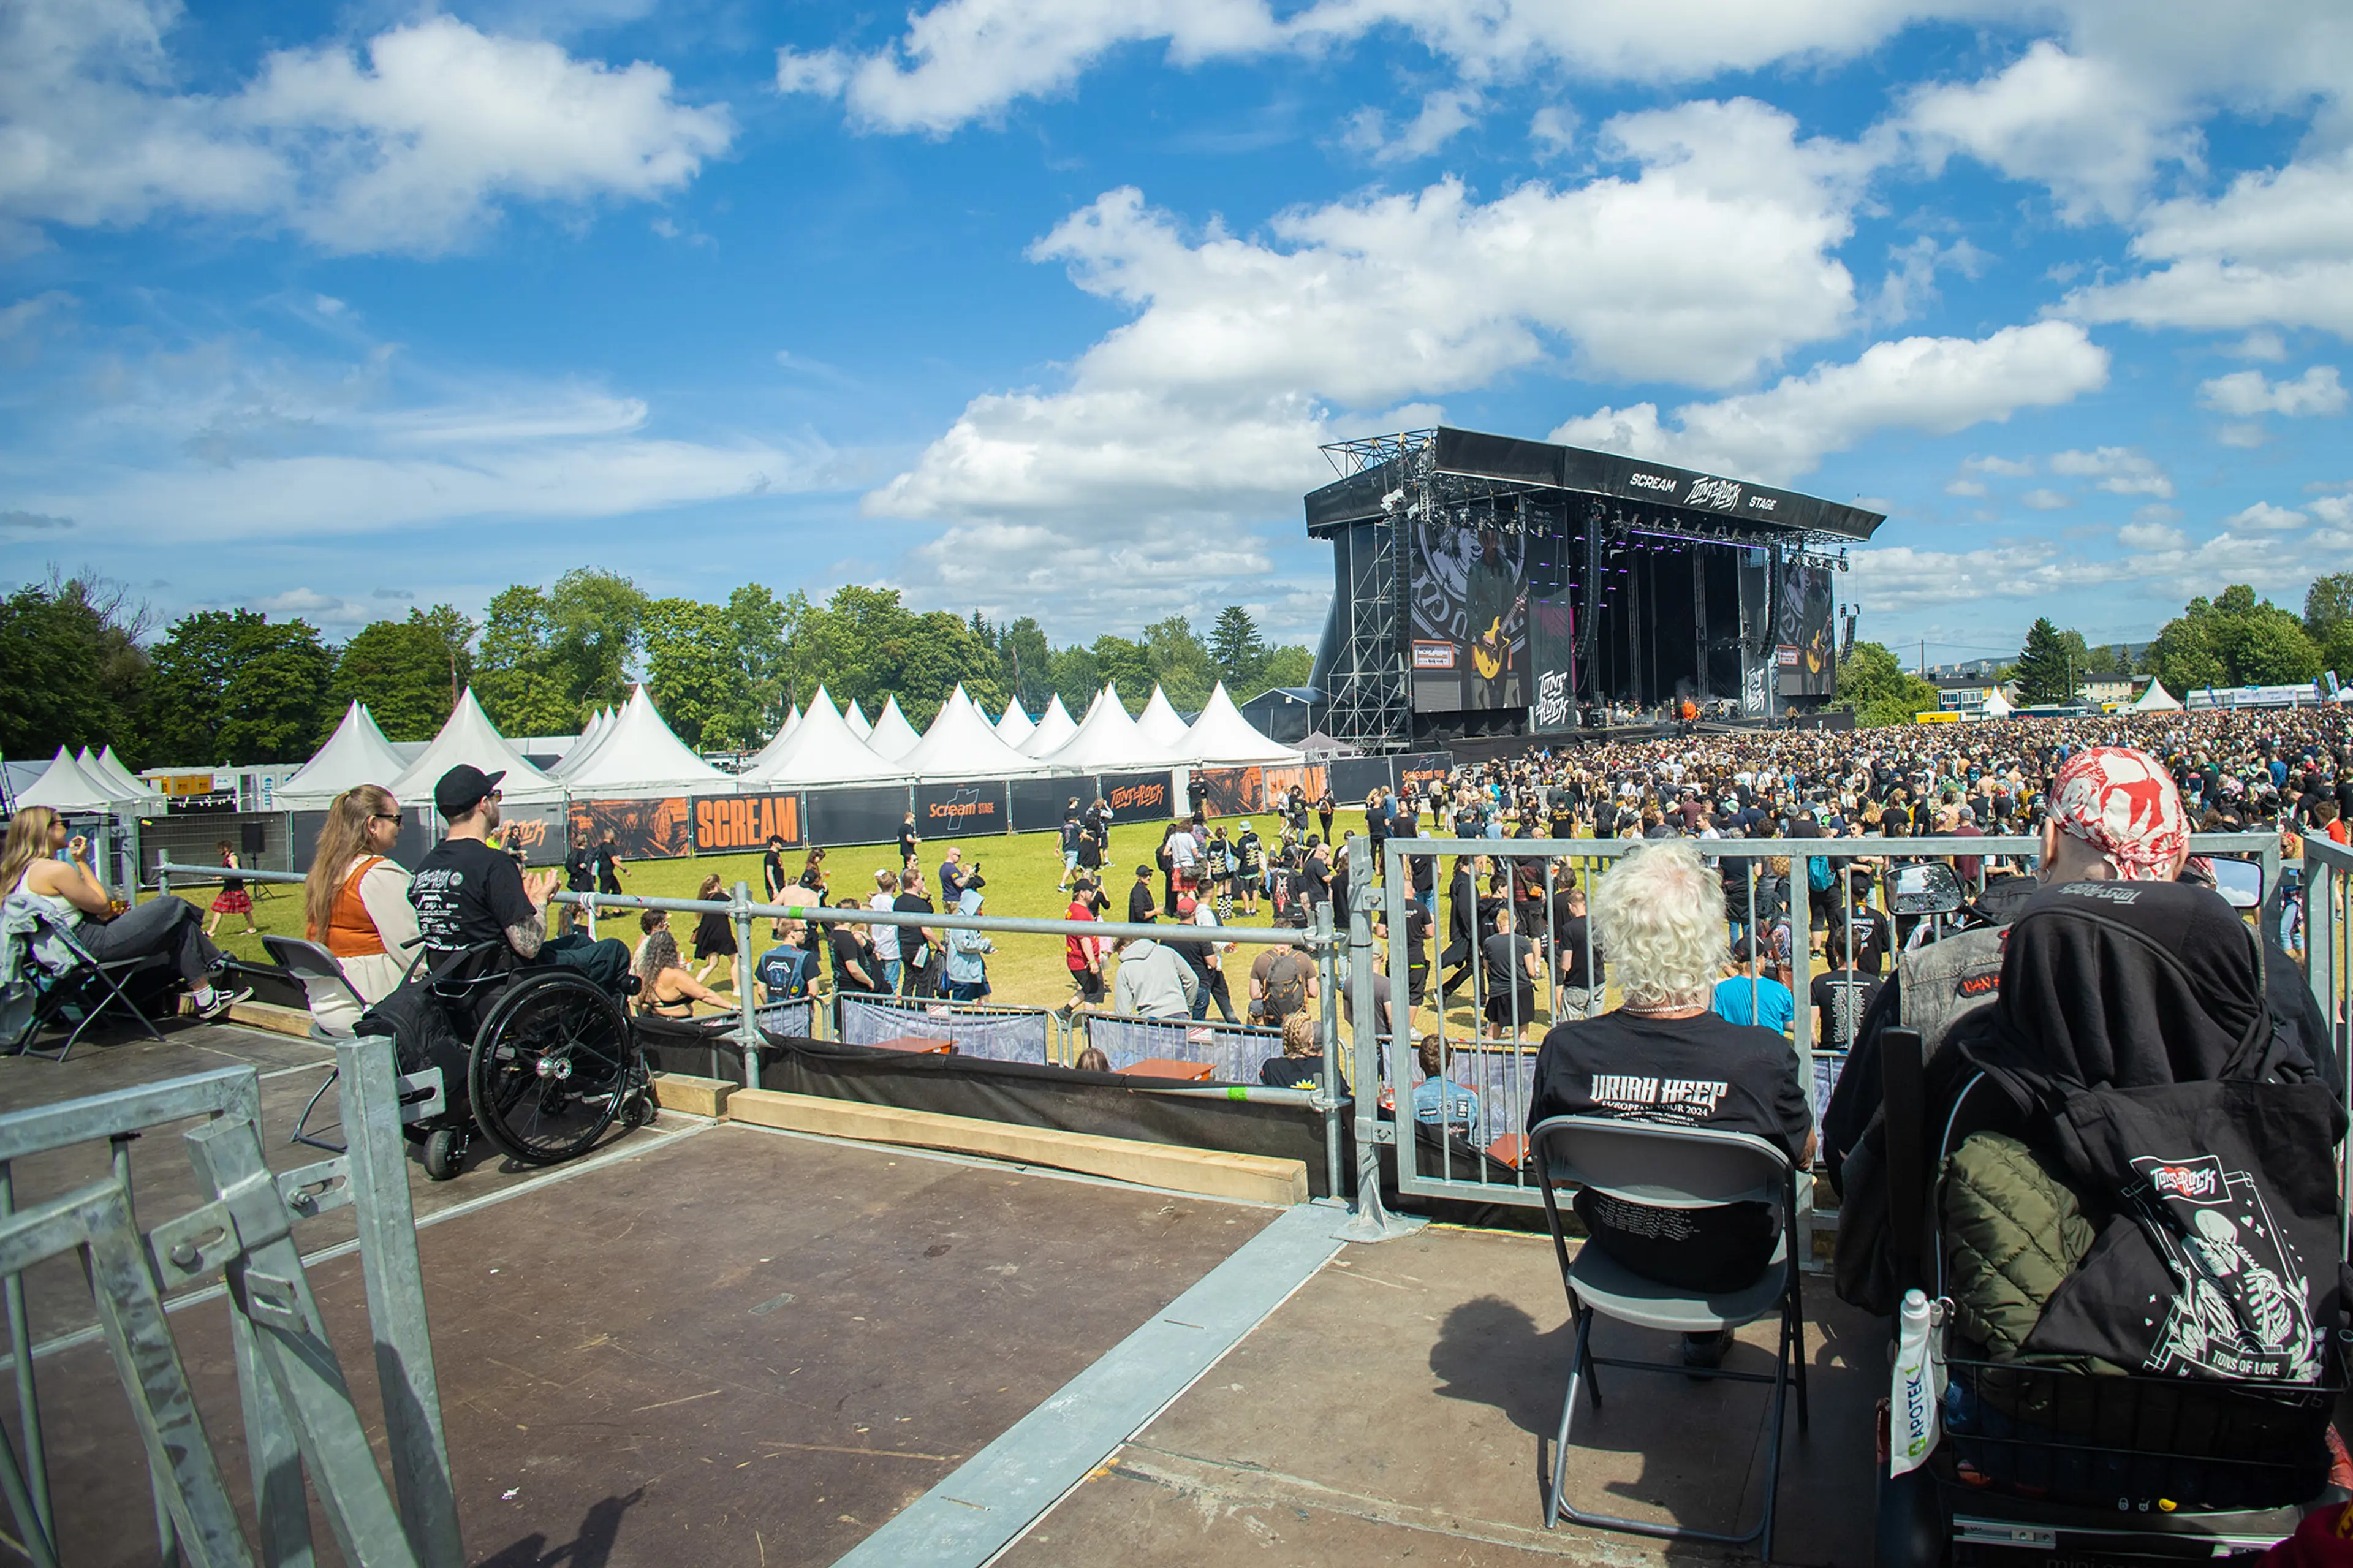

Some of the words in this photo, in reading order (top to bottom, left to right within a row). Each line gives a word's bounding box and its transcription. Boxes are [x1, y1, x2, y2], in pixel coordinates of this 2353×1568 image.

[1629, 473, 1677, 493] SCREAM
[1749, 496, 1777, 511] STAGE
[1538, 670, 1567, 701] TONS
[1536, 696, 1569, 725] ROCK
[929, 803, 976, 817] Scream
[1110, 786, 1136, 809] TONS
[1133, 783, 1164, 807] ROCK
[697, 797, 798, 848] SCREAM
[1590, 1074, 1658, 1103] URIAH
[1661, 1078, 1728, 1113] HEEP
[1656, 1104, 1684, 1114] TOUR
[1686, 1105, 1708, 1117] 2024
[2150, 1167, 2179, 1191] TONS
[2176, 1168, 2216, 1195] ROCK
[1905, 1362, 1919, 1376] 1
[2212, 1349, 2238, 1371] TONS
[2238, 1359, 2254, 1373] OF
[2255, 1362, 2279, 1376] LOVE
[1906, 1379, 1925, 1438] APOTEK
